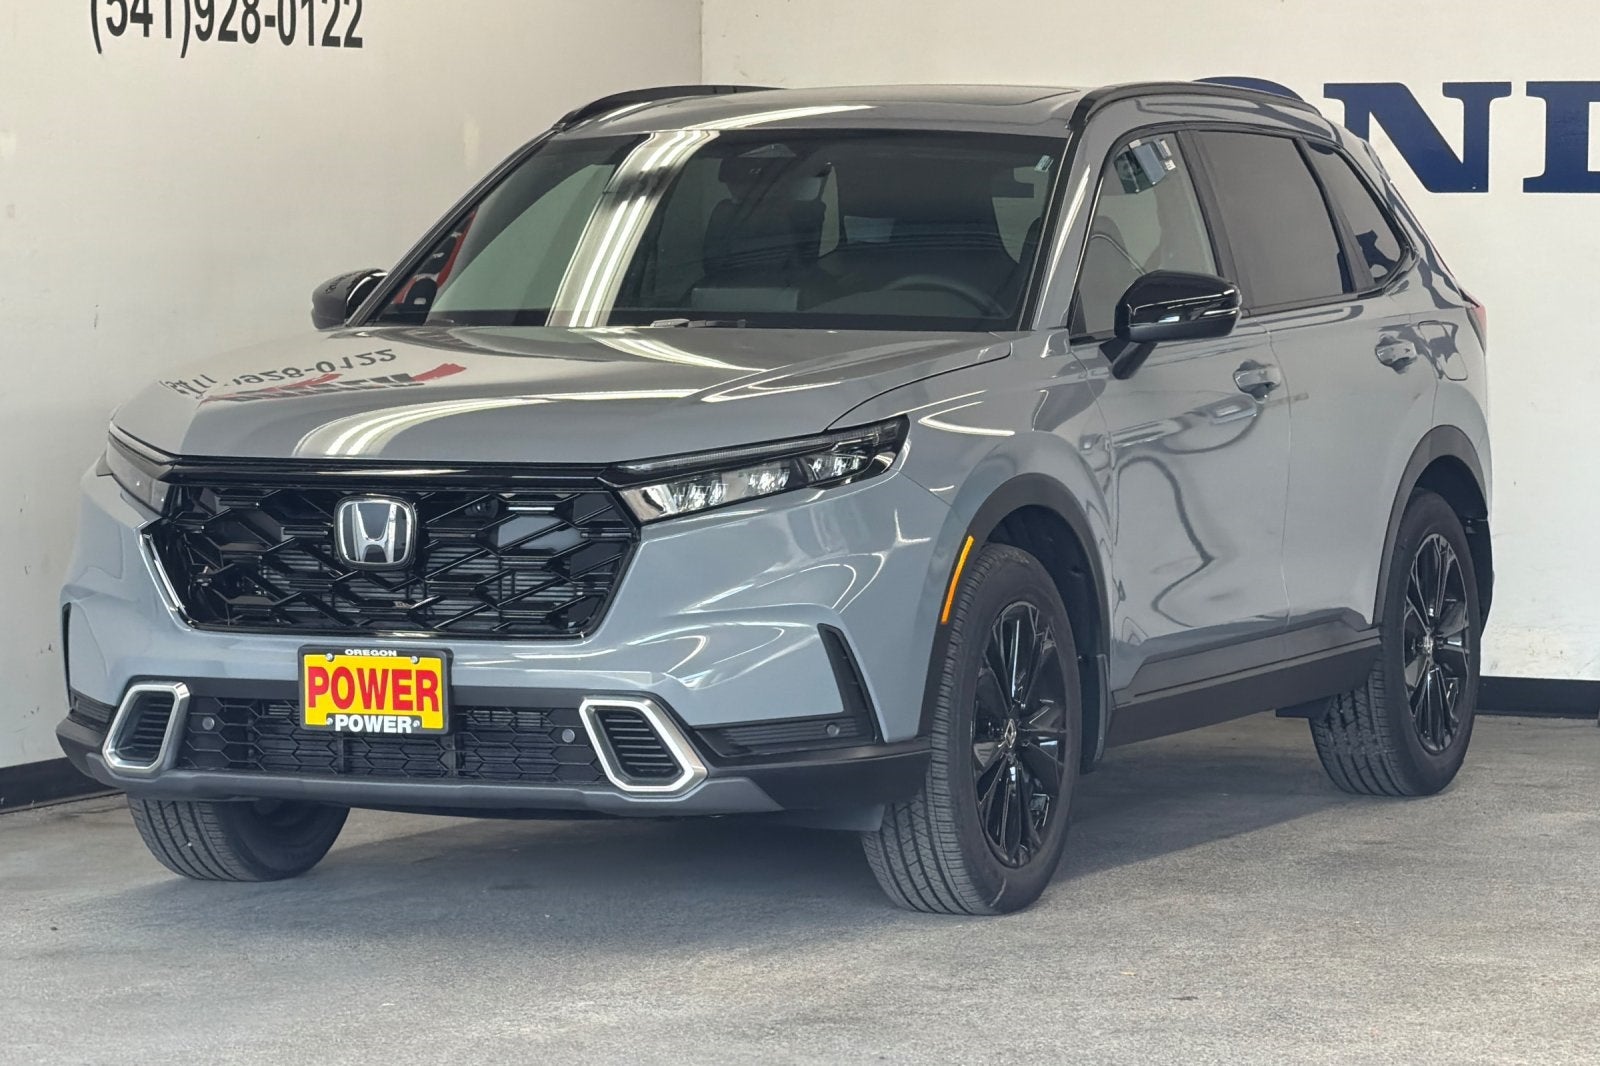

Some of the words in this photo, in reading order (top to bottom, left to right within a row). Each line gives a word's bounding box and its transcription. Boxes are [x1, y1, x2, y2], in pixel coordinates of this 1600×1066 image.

[344, 648, 398, 657] OREGON
[307, 665, 440, 712] POWER
[334, 714, 413, 734] POWER
